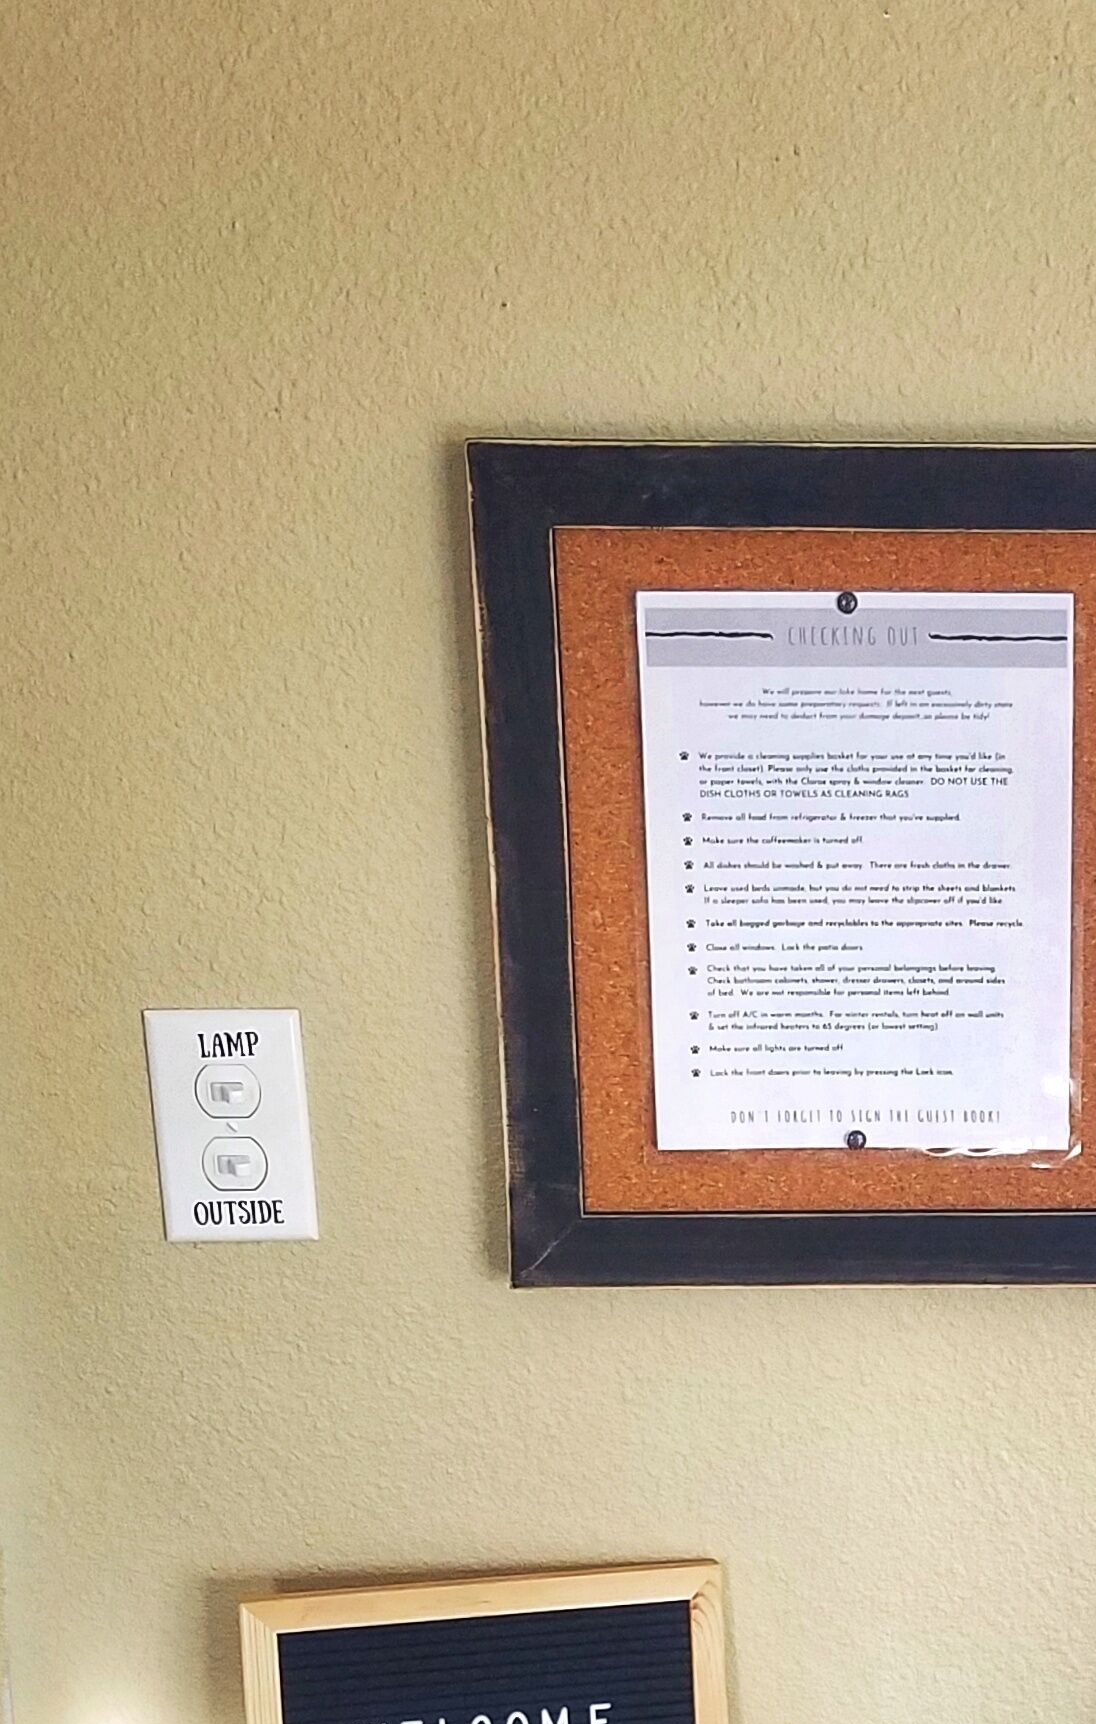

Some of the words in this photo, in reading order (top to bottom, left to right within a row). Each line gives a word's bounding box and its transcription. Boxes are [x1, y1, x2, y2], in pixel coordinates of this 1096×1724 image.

[789, 626, 876, 645] CHECKING
[888, 626, 917, 645] OUT
[700, 790, 721, 798] DISH
[724, 790, 760, 798] CLOTHS
[780, 790, 818, 798] TOWELS
[835, 790, 883, 798] CLEANING
[702, 836, 724, 844] Make
[762, 836, 811, 844] coffeemaker
[197, 1032, 259, 1058] LAMP
[778, 1110, 821, 1122] FORGET
[830, 1110, 842, 1122] TO
[851, 1110, 881, 1122] SIGN
[890, 1110, 908, 1122] THE
[917, 1110, 954, 1122] GUEST
[963, 1111, 1000, 1123] BOOK!
[194, 1200, 285, 1225] OUTSIDE
